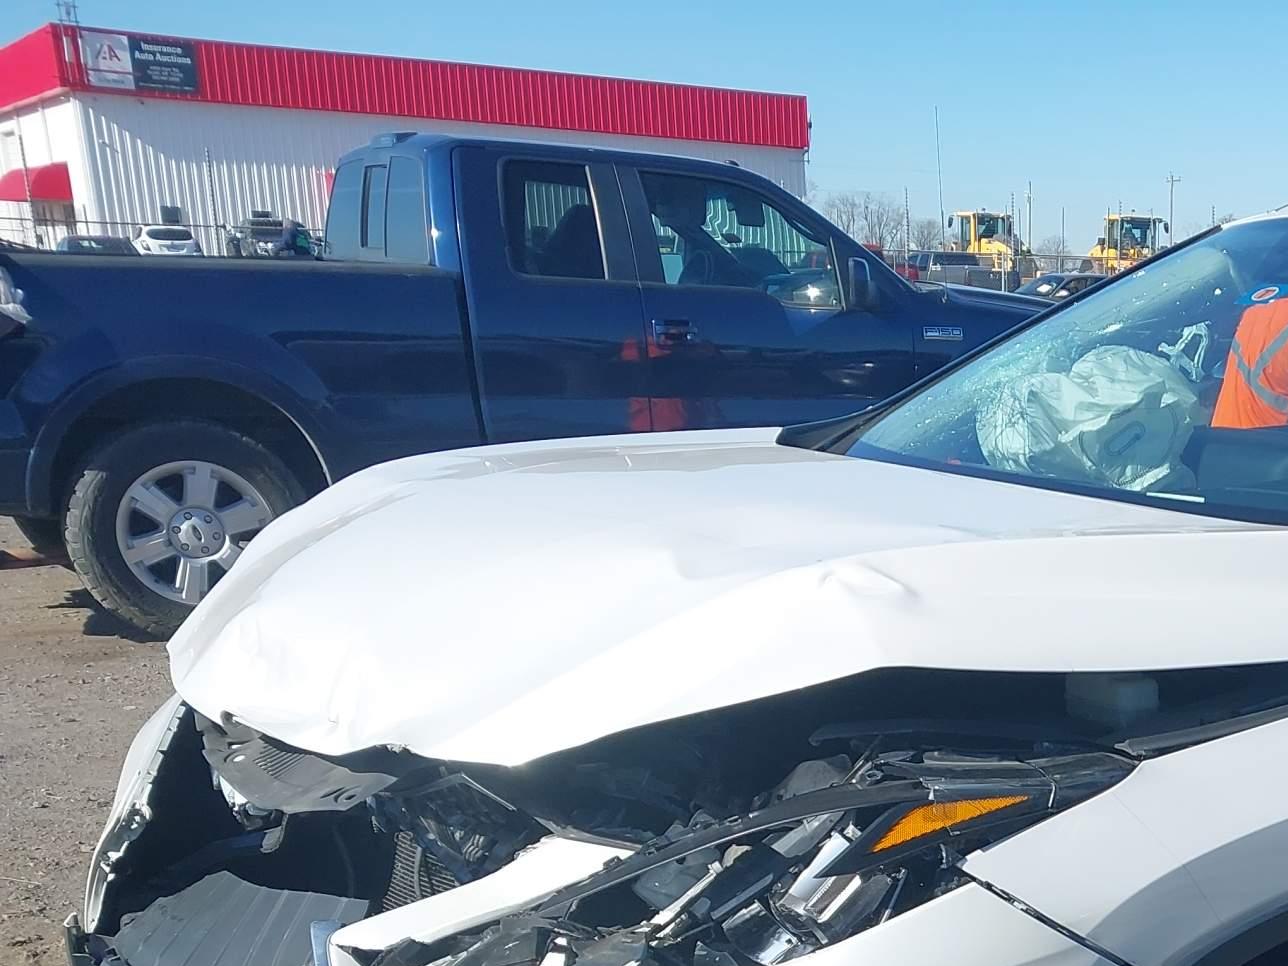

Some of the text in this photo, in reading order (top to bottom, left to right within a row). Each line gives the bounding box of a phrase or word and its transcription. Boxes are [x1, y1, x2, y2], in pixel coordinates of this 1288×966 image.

[140, 41, 182, 54] Insurance
[135, 50, 192, 64] Auto Auctions
